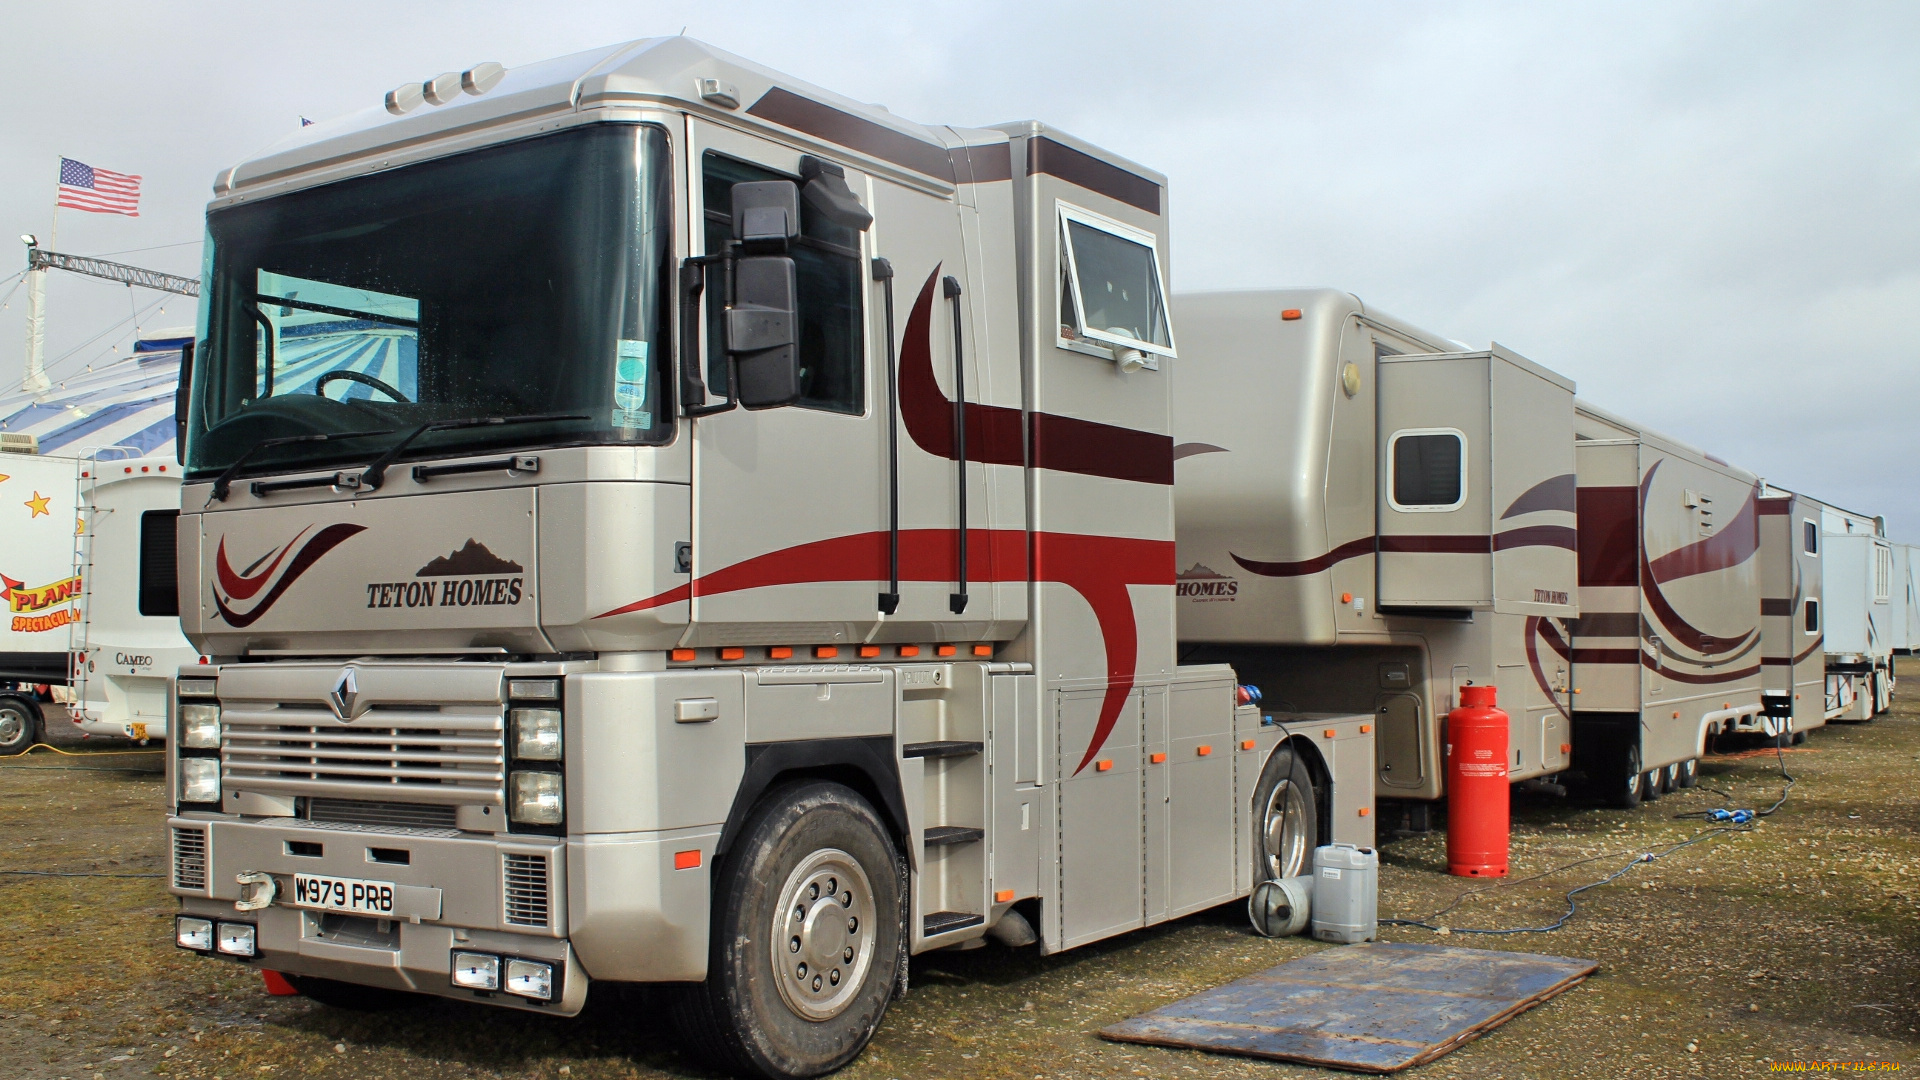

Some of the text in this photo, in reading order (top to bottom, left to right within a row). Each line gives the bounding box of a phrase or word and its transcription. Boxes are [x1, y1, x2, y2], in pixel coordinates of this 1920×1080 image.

[367, 578, 523, 608] TETON HOMES
[1176, 581, 1238, 597] HOMES
[11, 608, 82, 632] SPECTACULA
[116, 652, 153, 667] CAMEO
[296, 878, 393, 912] W979 PRB
